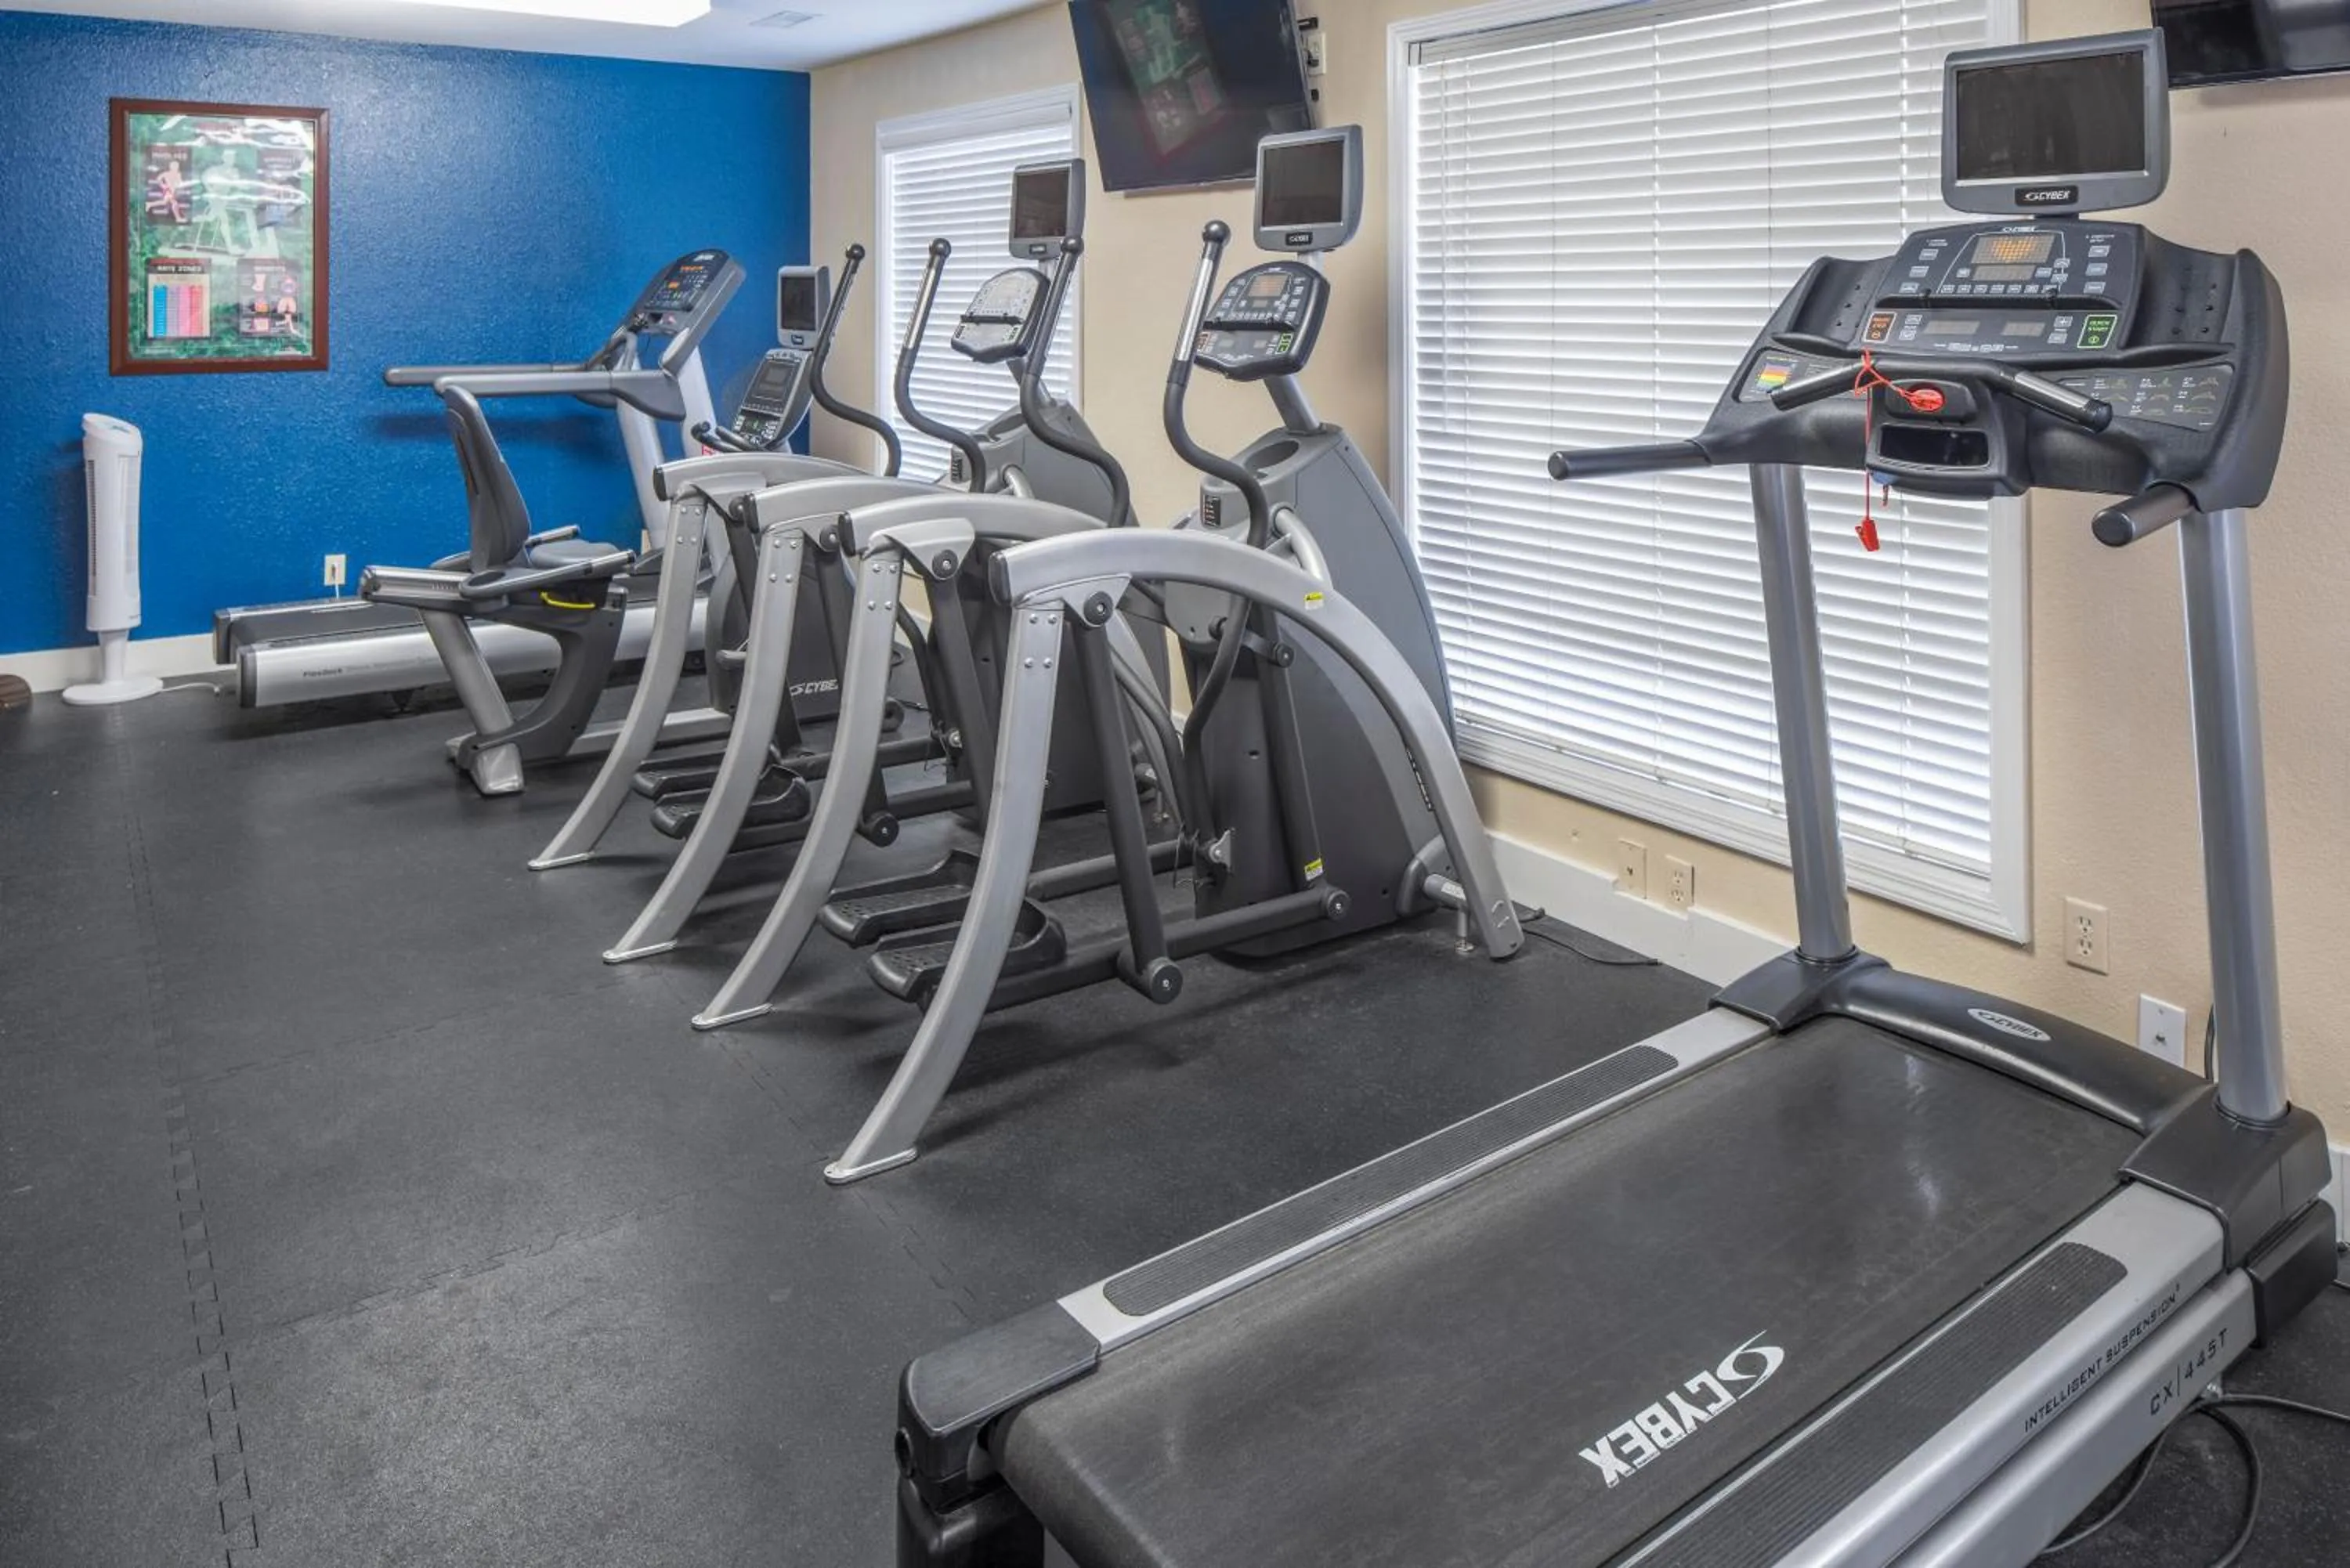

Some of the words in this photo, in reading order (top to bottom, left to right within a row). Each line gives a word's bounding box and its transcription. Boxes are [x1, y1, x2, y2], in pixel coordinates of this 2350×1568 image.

[2039, 190, 2071, 201] CYBEX
[804, 678, 839, 695] CYBE
[2024, 1357, 2102, 1433] INTELLIGENT
[2105, 1293, 2176, 1363] SUSPENSION
[1578, 1369, 1737, 1489] CYBEX
